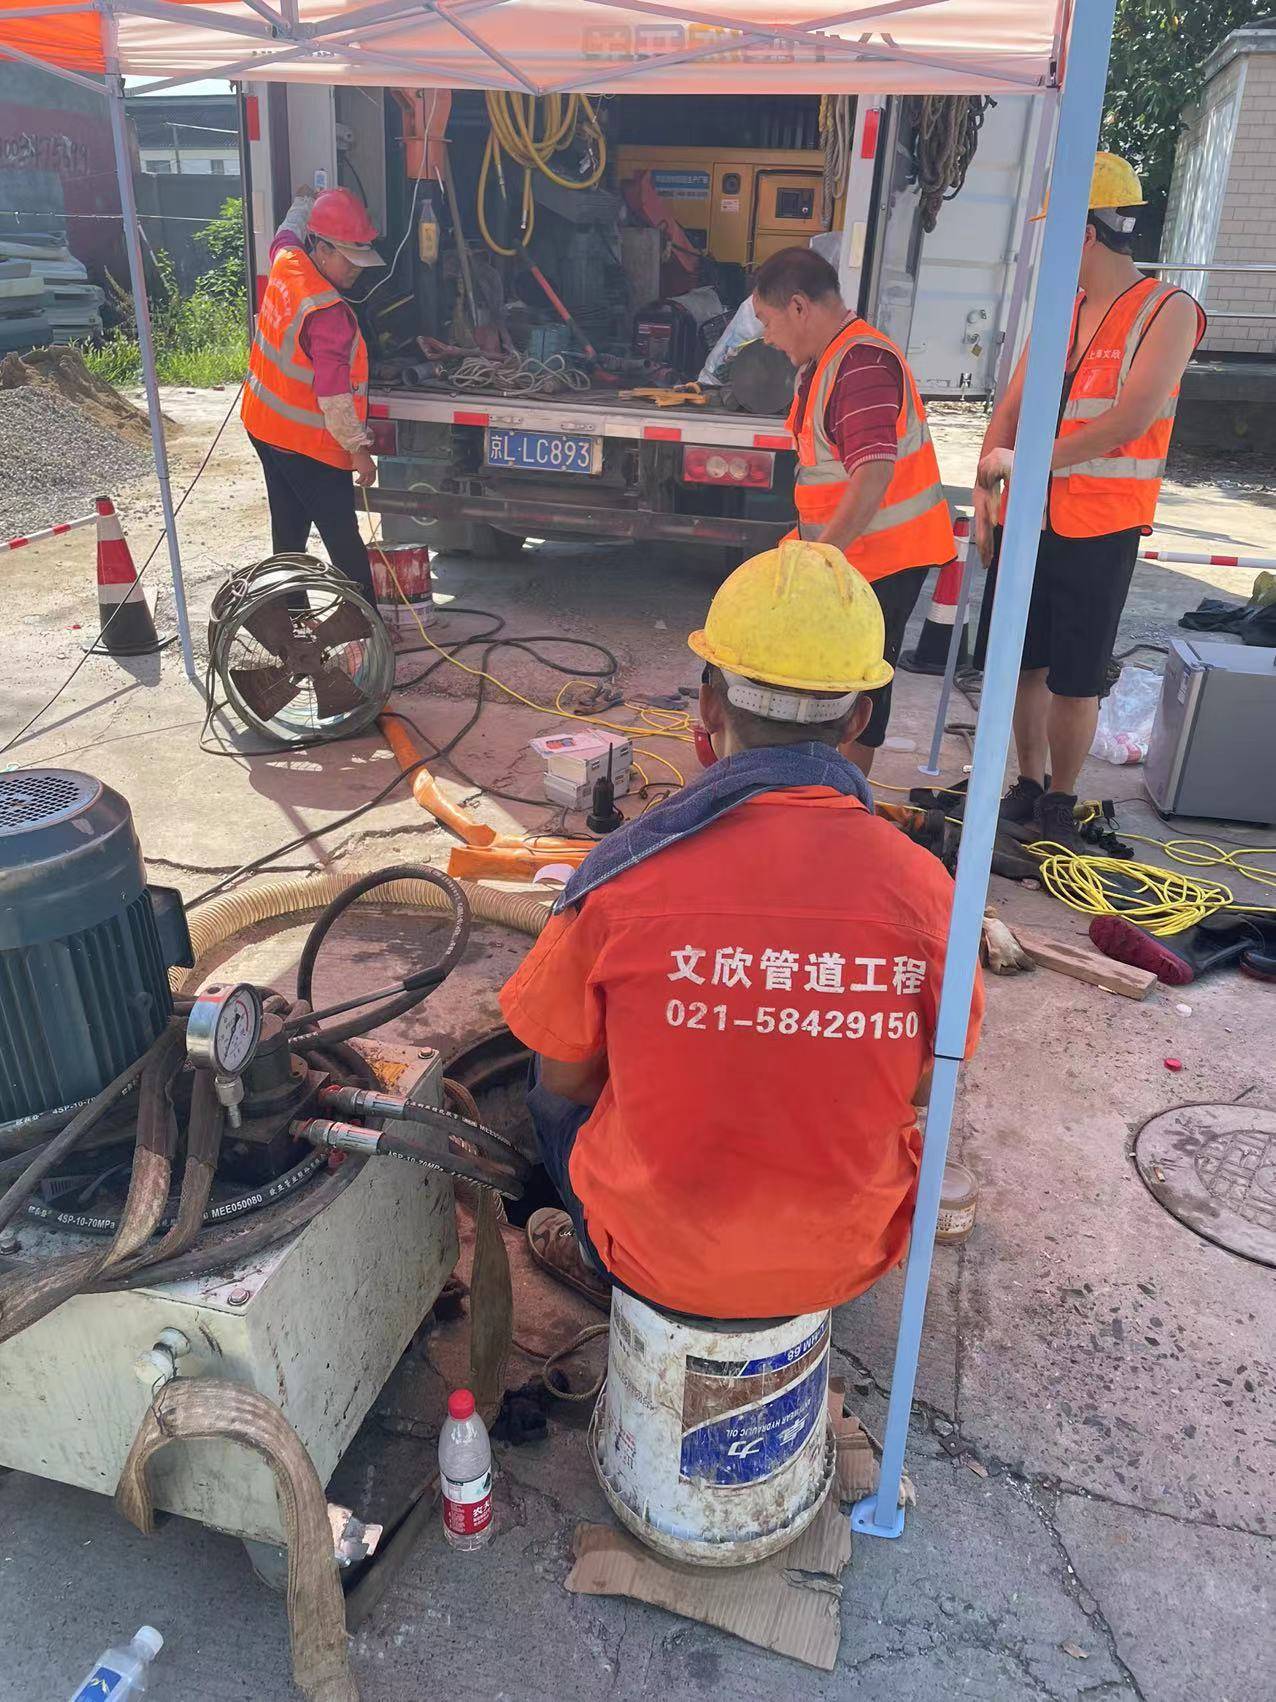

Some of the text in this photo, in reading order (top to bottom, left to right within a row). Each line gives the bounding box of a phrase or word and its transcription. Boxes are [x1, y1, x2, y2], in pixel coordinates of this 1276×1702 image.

[667, 945, 927, 995] 文欣管道工程
[666, 999, 919, 1040] 021-58429150
[211, 1194, 263, 1219] MEE050080
[57, 1212, 116, 1230] 4SP-10-70MPa
[787, 1346, 801, 1361] 68
[726, 1429, 739, 1438] OIL
